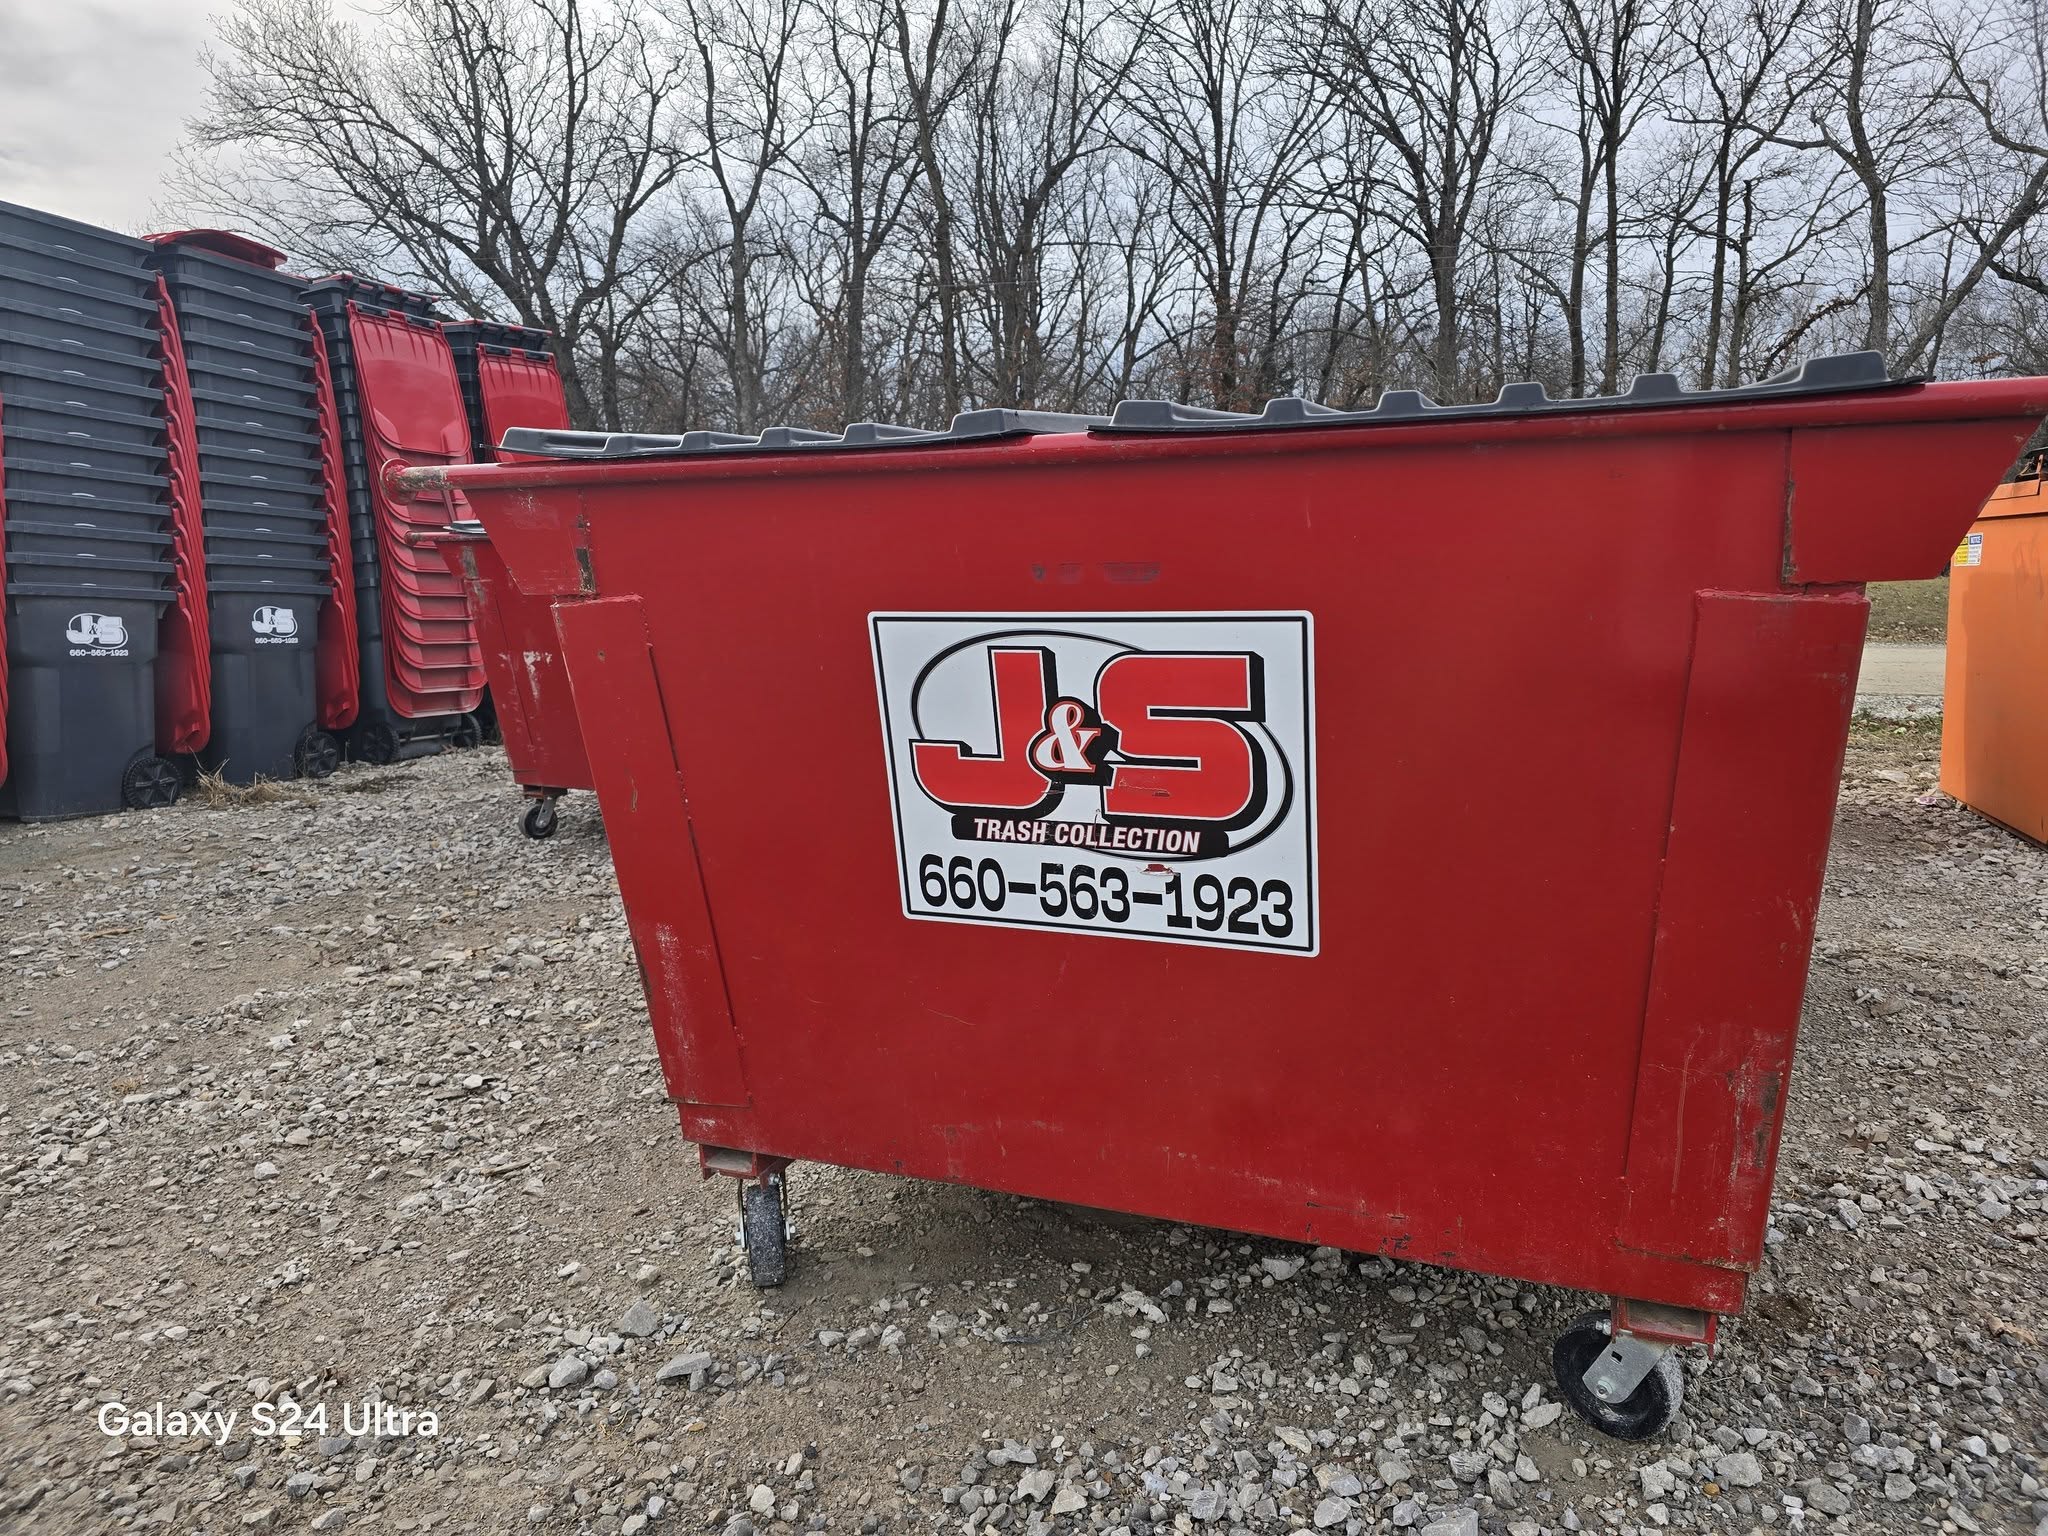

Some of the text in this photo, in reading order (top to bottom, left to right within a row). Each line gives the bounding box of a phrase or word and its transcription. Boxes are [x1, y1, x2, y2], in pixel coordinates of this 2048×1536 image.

[66, 615, 124, 645] J&S
[252, 608, 295, 634] J&S
[908, 645, 1268, 832] J&S
[973, 817, 1201, 854] TRASH COLLECTION
[918, 853, 1294, 939] 660-563-1923
